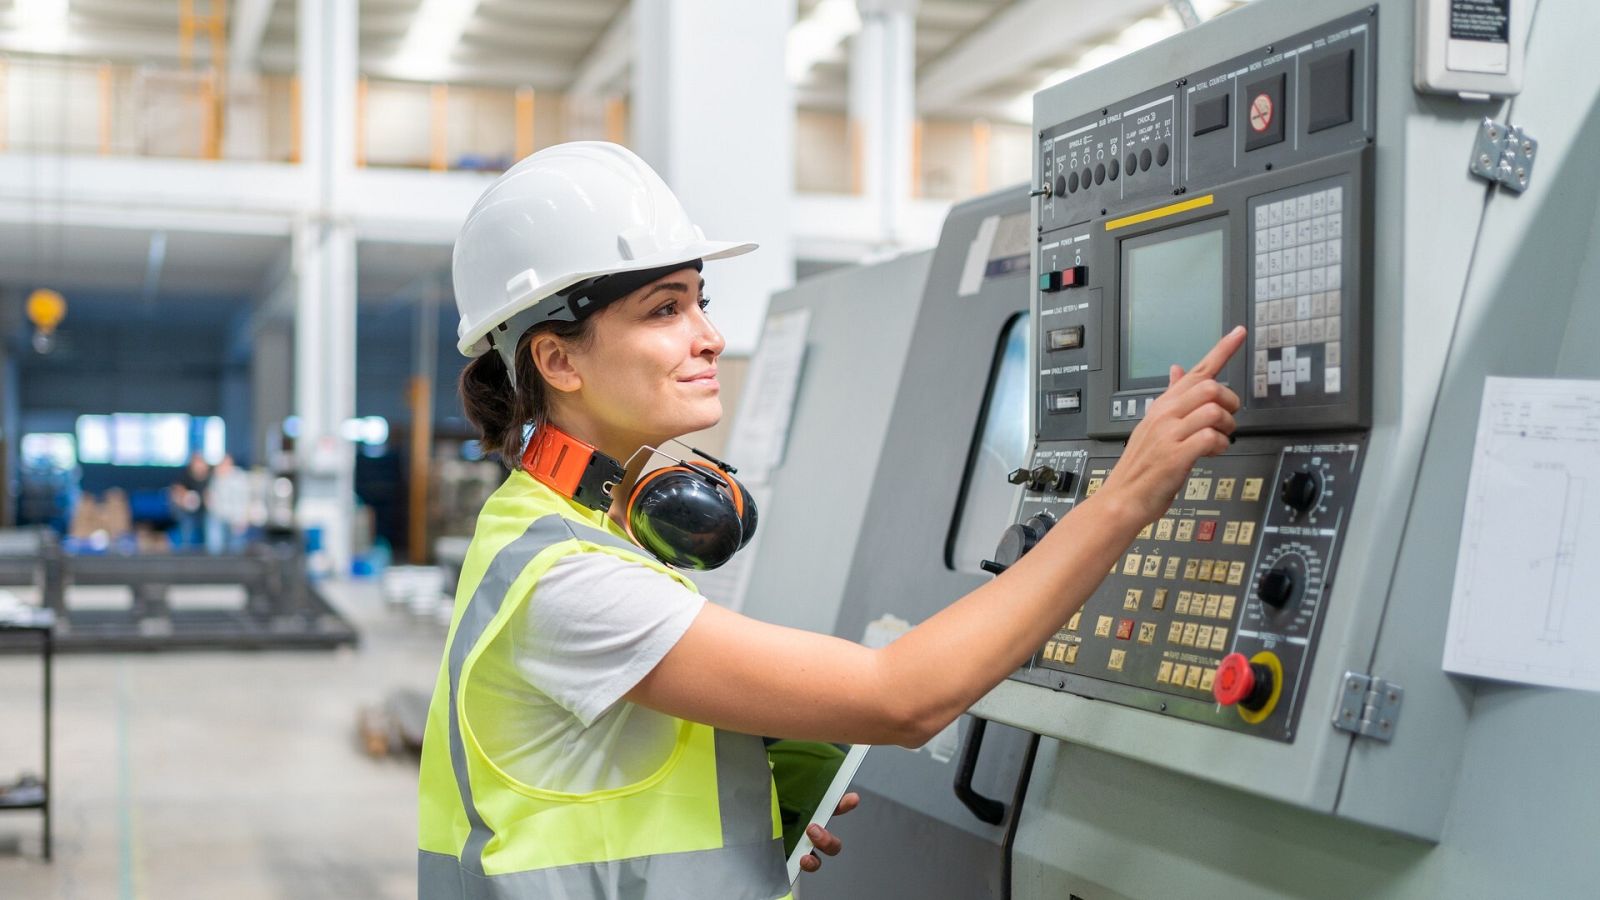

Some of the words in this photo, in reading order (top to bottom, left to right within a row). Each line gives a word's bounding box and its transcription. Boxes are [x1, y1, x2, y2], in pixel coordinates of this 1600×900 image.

[1327, 29, 1350, 44] COUNTER
[1263, 53, 1283, 66] COUNTER
[1196, 80, 1209, 91] TOTAL
[1209, 73, 1227, 87] COUNTER
